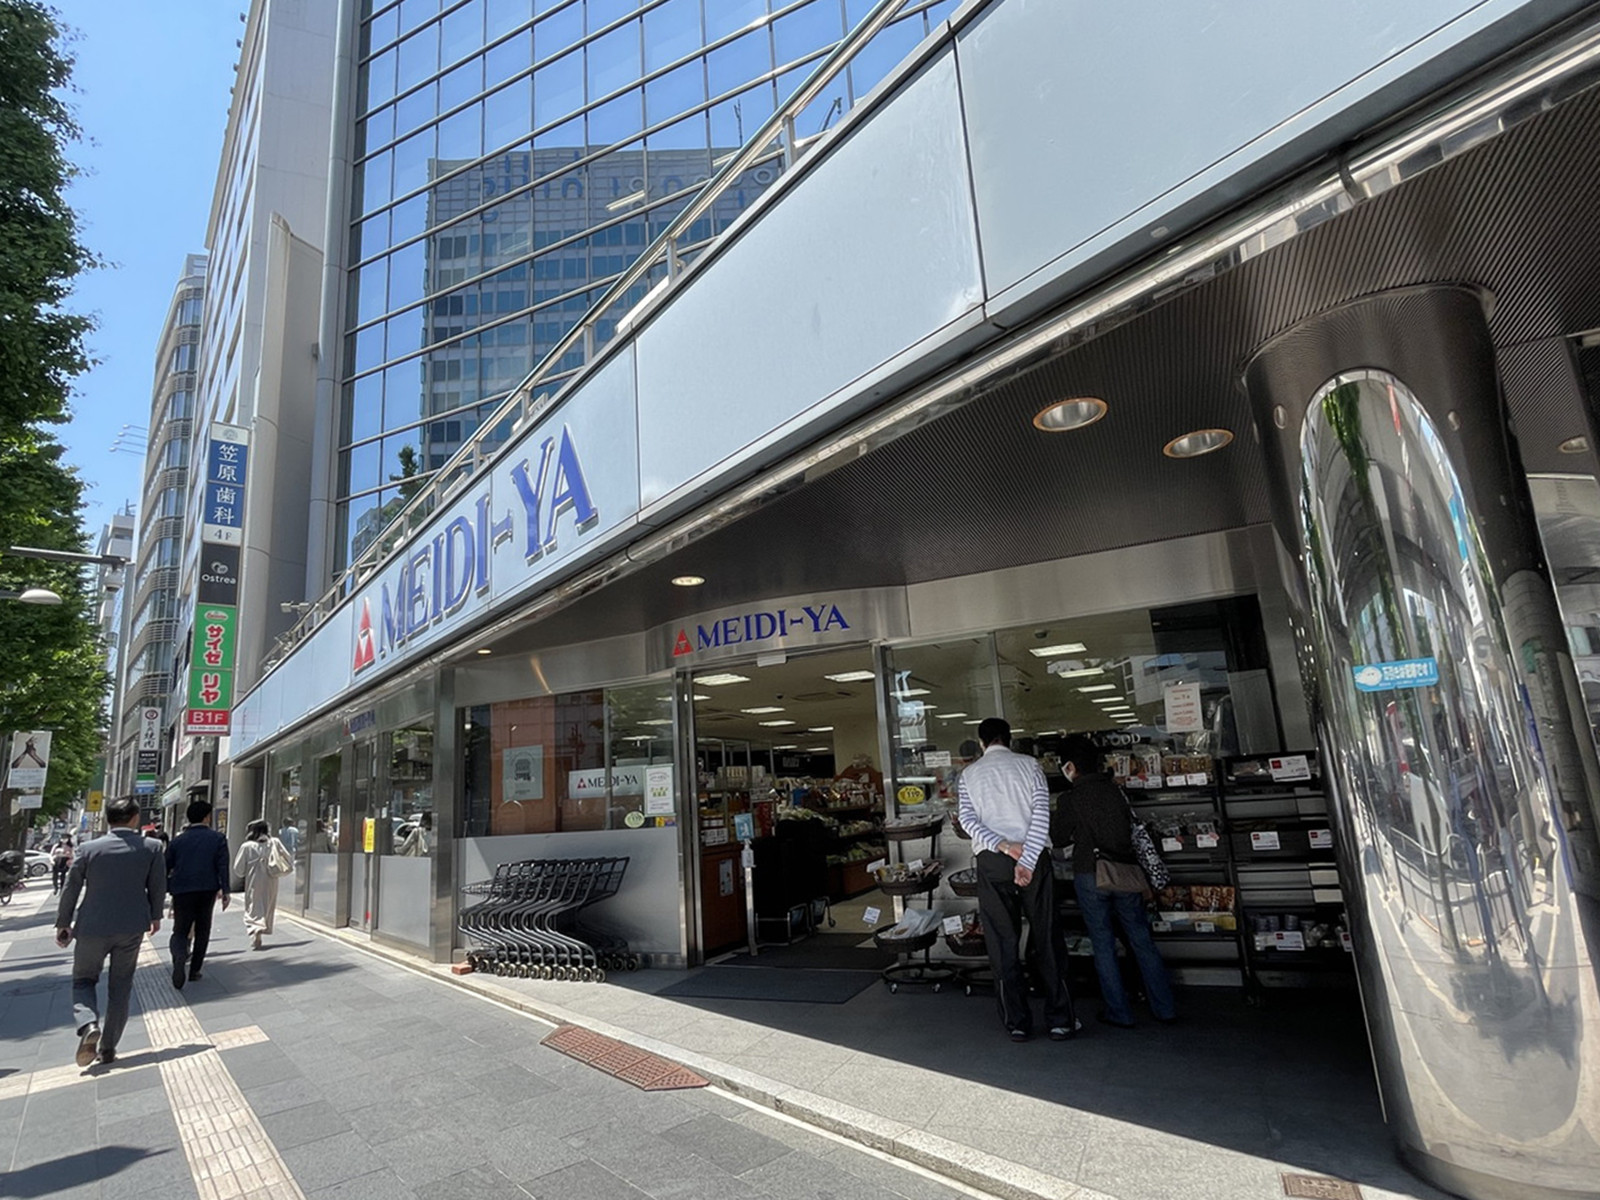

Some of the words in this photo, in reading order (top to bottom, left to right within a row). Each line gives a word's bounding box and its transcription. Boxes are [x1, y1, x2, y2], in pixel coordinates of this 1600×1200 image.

[213, 444, 239, 525] 笠原歯科
[214, 529, 232, 540] 4F
[379, 423, 599, 660] MEIDI-YA
[201, 574, 237, 585] Ostrea
[697, 604, 850, 651] MEIDI-YA
[199, 624, 225, 705] サイゼリヤ
[192, 711, 224, 724] B1F
[587, 774, 638, 789] MEDI-YA
